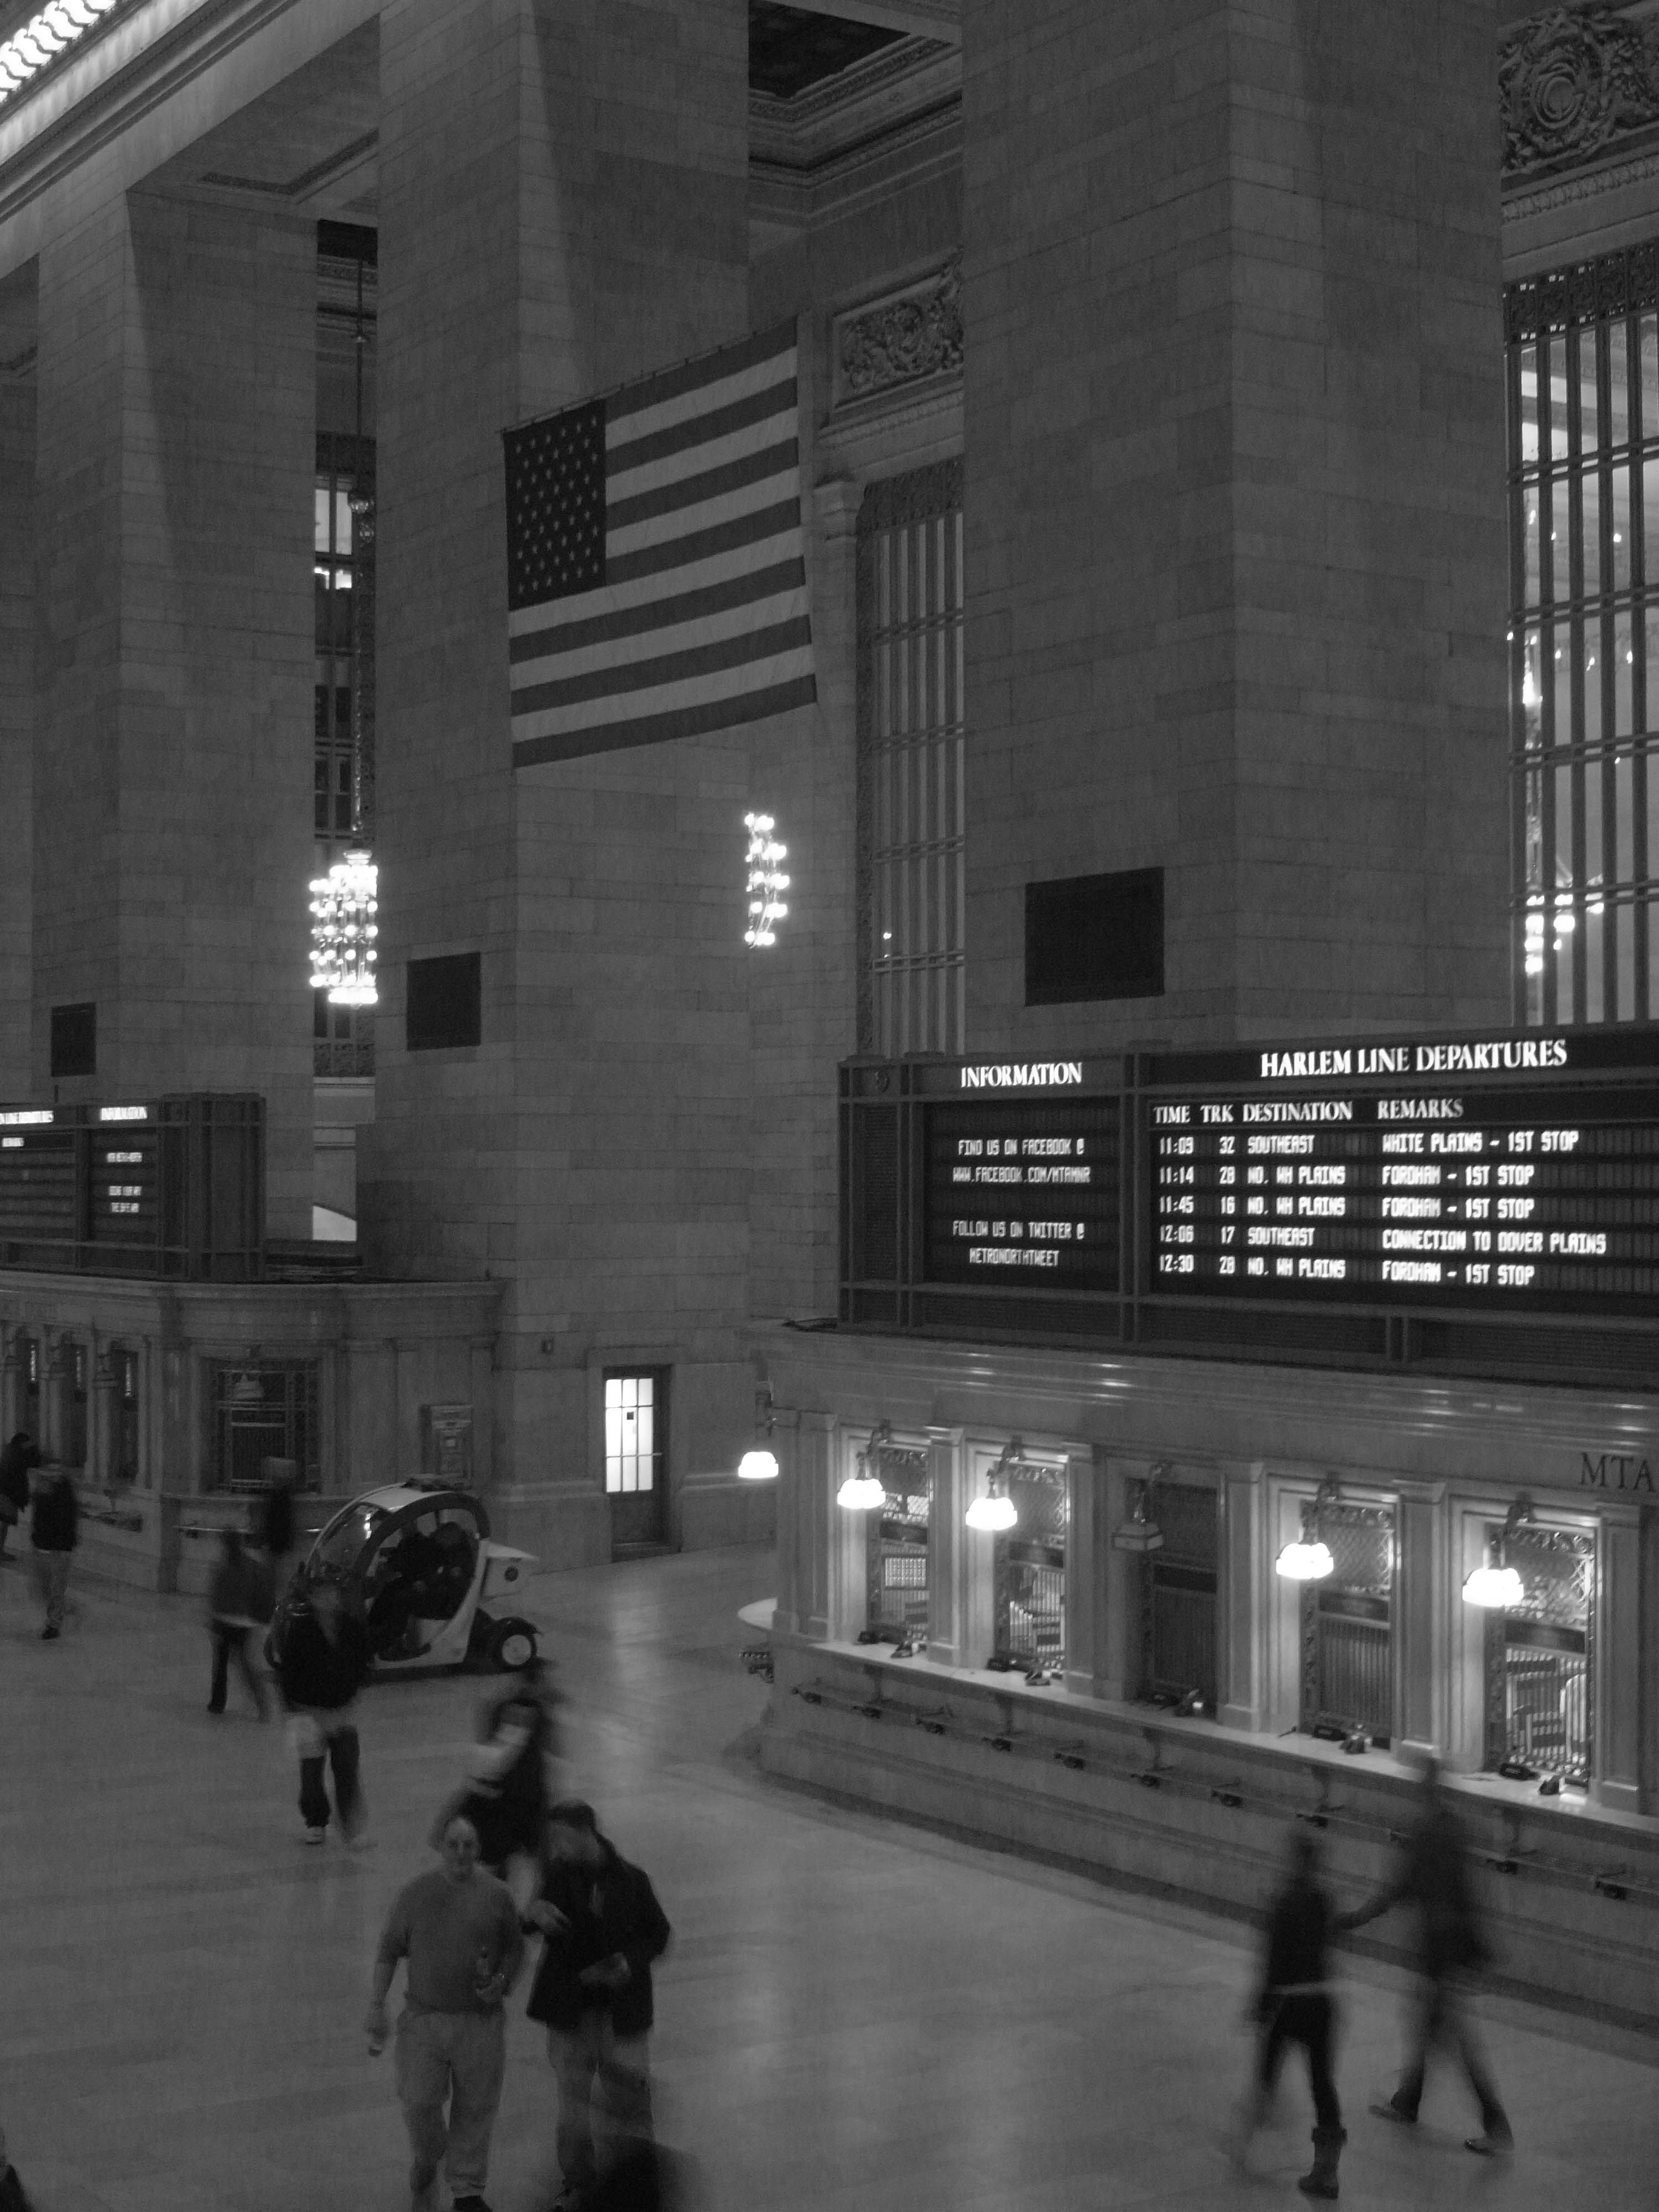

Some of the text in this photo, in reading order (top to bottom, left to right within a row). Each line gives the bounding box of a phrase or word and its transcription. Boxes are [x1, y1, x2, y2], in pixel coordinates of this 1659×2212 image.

[1261, 1040, 1567, 1077] HARLEM LINE DEPARTURES
[962, 1063, 1082, 1088] INFORMATION
[1155, 1107, 1191, 1124] TIME
[1201, 1105, 1234, 1123] TRK
[1244, 1102, 1353, 1122] DESTINATION
[1379, 1099, 1463, 1120] REMARKS
[959, 1140, 983, 1156] FIND
[988, 1140, 1000, 1156] US
[1005, 1140, 1018, 1155] ON
[1023, 1139, 1072, 1156] FACEBOOK
[1220, 1137, 1235, 1155] 32
[1248, 1135, 1315, 1154] SOUTHEAST
[1383, 1134, 1425, 1154] WHITE
[1431, 1133, 1483, 1154] PLAINS
[1509, 1131, 1535, 1152] 1ST
[1541, 1131, 1579, 1152] STOP
[1161, 1167, 1194, 1184] 11:14
[1248, 1166, 1269, 1185] NO.
[1277, 1167, 1293, 1185] WH
[1299, 1166, 1346, 1186] PLAINS
[1383, 1166, 1441, 1186] FORDHAM
[1466, 1166, 1491, 1186] 1ST
[1498, 1166, 1535, 1186] STOP
[1161, 1197, 1346, 1217] 11:45 16 NO. WH PLAINS
[1383, 1198, 1441, 1218] FORDHAM
[1466, 1199, 1491, 1219] 1ST
[1498, 1199, 1535, 1219] STOP
[953, 1221, 989, 1237] FOLLOW
[993, 1222, 1006, 1238] US
[1011, 1222, 1024, 1238] ON
[1029, 1223, 1072, 1239] TWITTER
[1161, 1225, 1316, 1246] 12:06 17 SOUTHEAST
[1383, 1230, 1606, 1255] CONNECTION TO DOVER PLAINS
[1161, 1255, 1194, 1273] 12:30
[1248, 1258, 1269, 1276] NO.
[1277, 1259, 1293, 1277] WH
[1299, 1259, 1346, 1279] PLAINS
[1383, 1261, 1442, 1283] FORDHAM
[1466, 1264, 1491, 1284] 1ST
[1498, 1265, 1535, 1286] STOP
[1579, 1452, 1656, 1491] MTA
